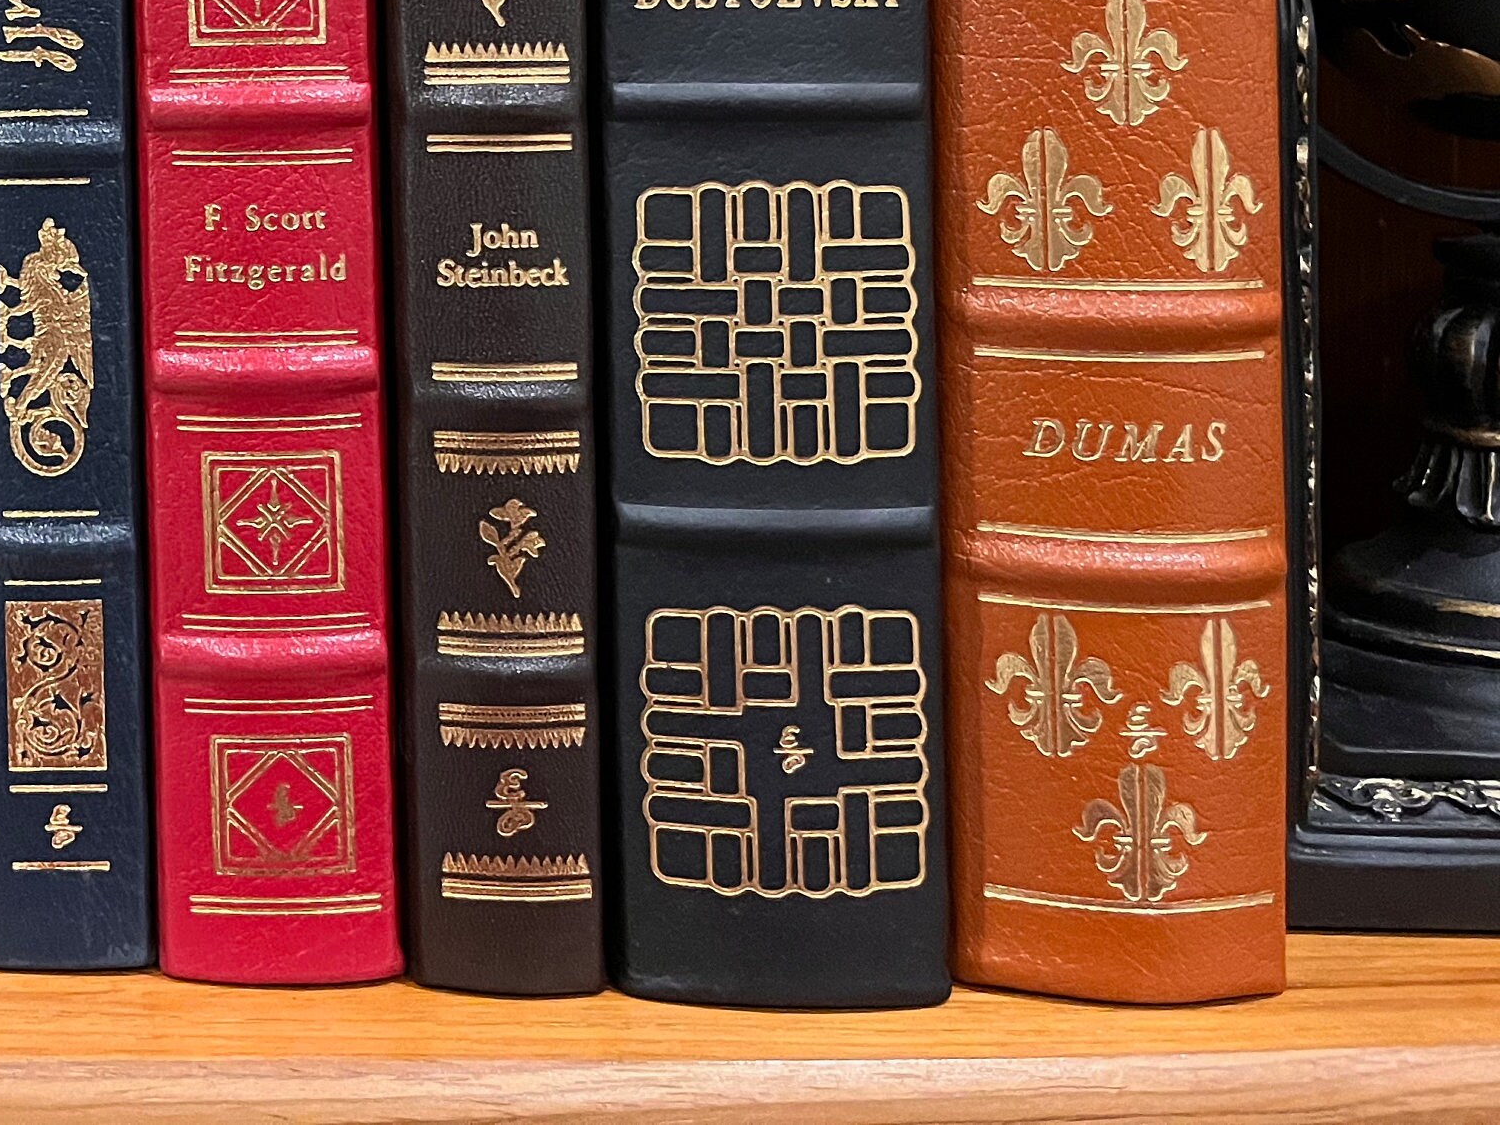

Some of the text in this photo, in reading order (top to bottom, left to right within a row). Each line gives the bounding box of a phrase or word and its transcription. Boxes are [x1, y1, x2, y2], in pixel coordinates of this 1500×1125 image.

[203, 204, 328, 232] F. Scott
[466, 222, 540, 258] John
[183, 253, 348, 291] Fitzgerald
[436, 257, 570, 289] Steinbeck
[1021, 418, 1228, 463] DUMAS
